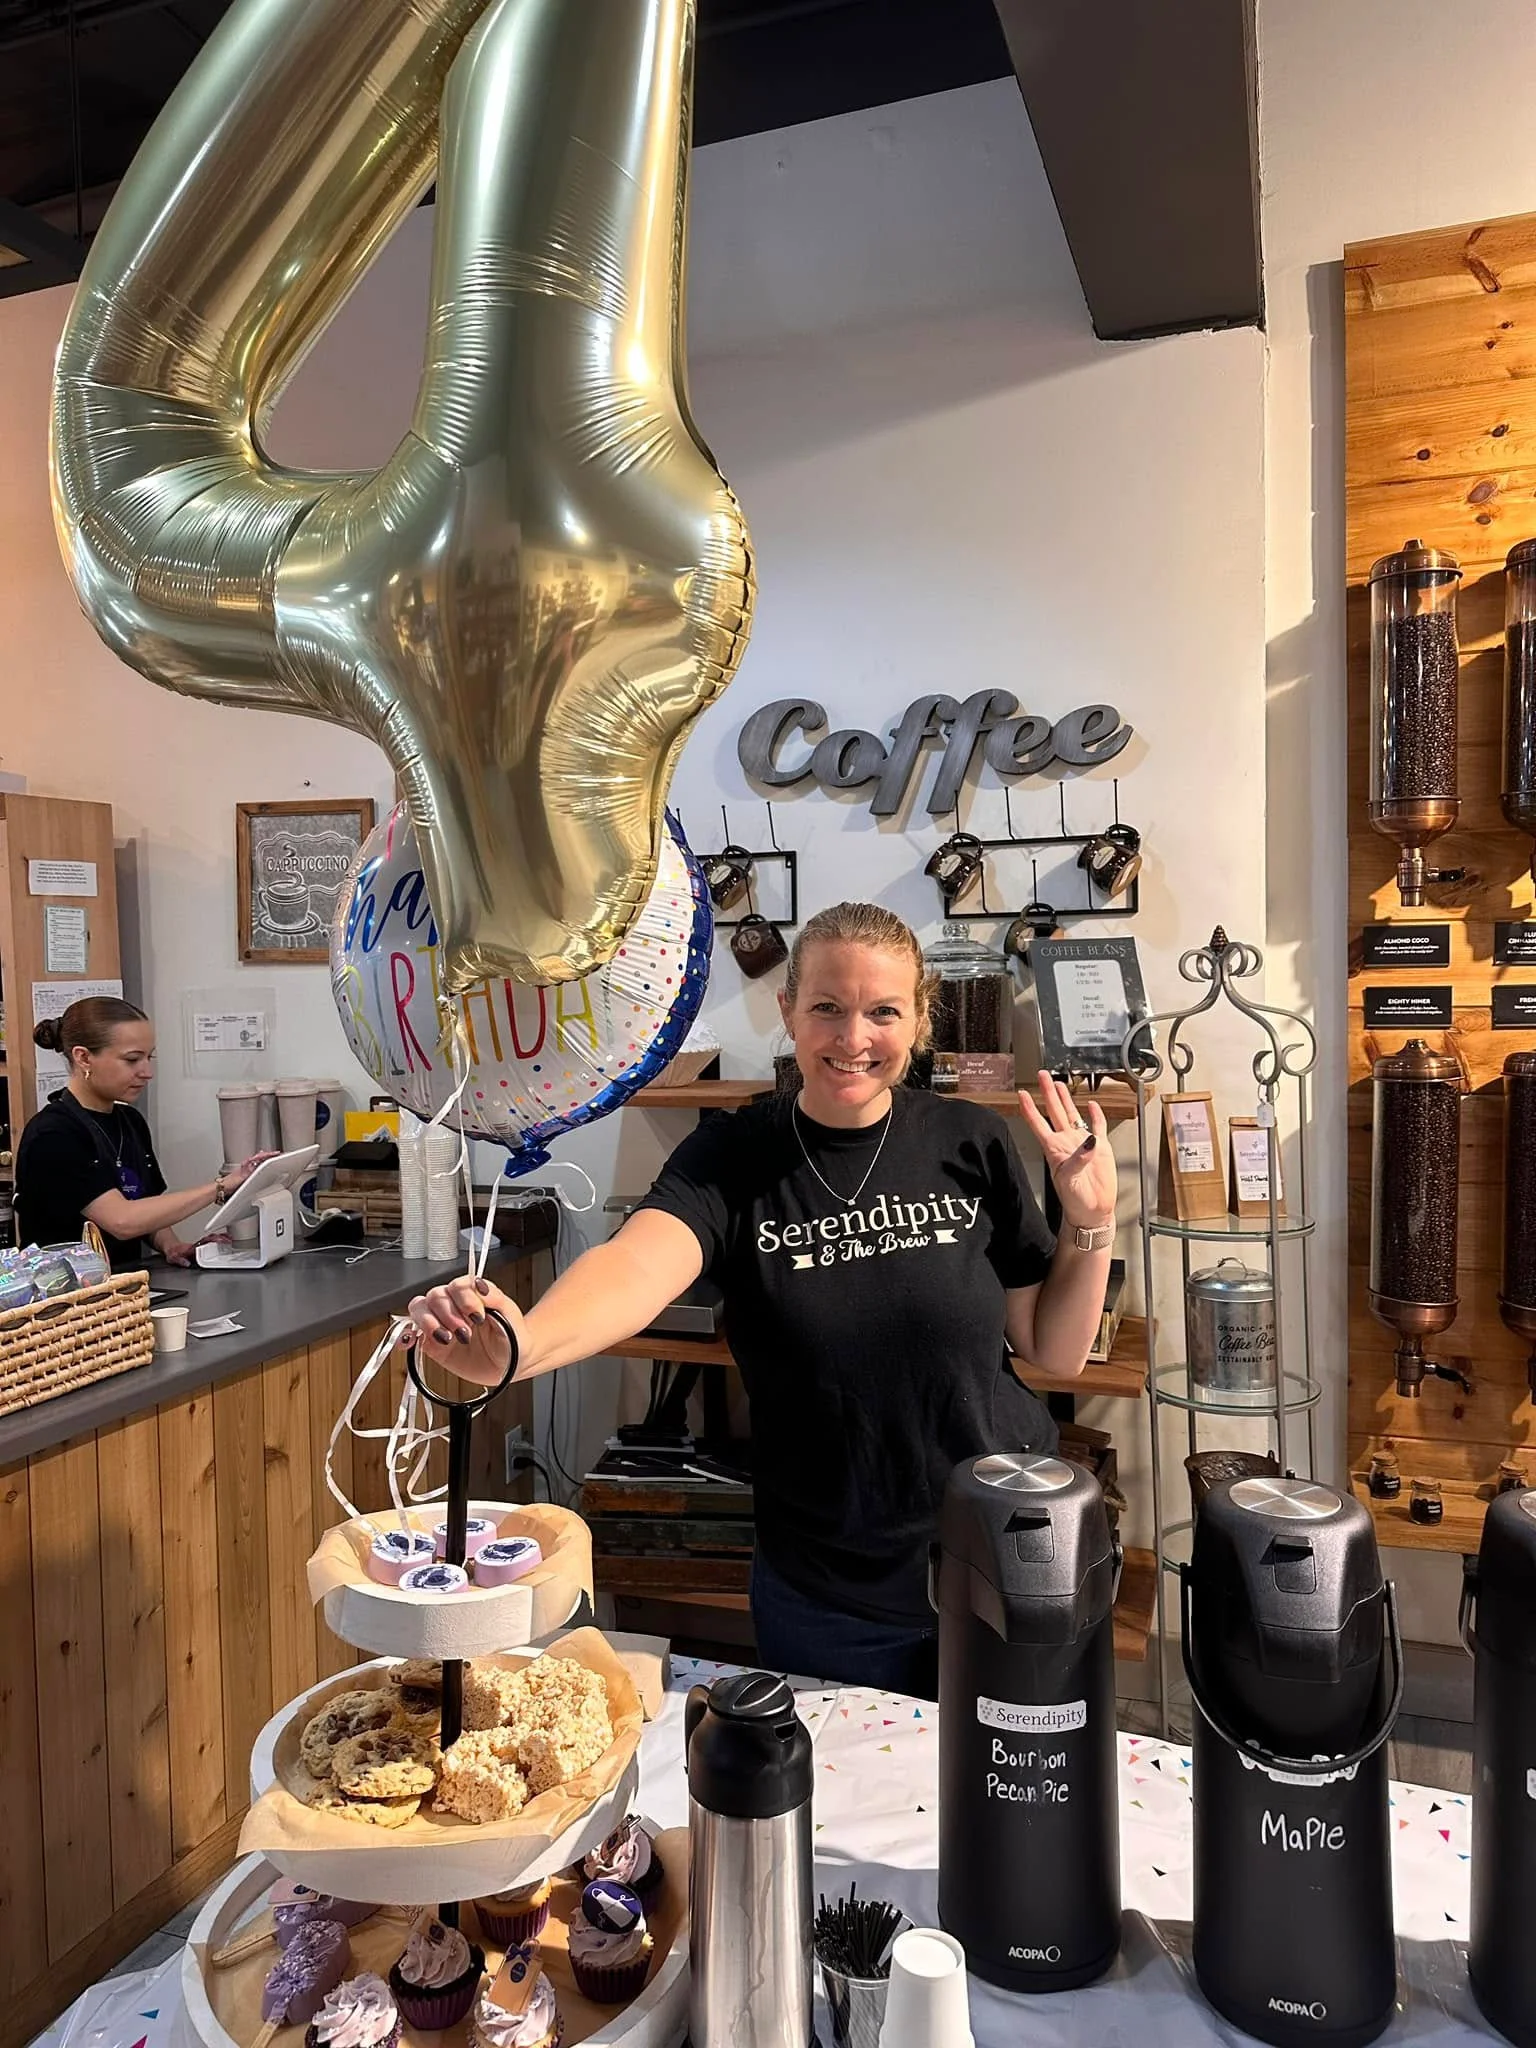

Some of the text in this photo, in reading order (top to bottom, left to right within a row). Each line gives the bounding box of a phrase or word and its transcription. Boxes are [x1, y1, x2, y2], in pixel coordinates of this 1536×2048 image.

[738, 688, 1133, 815] Coffee
[266, 856, 350, 873] CAPPUCCINO
[1040, 943, 1127, 957] COFFEE BEANS
[757, 1192, 983, 1253] Serendipity
[819, 1231, 931, 1266] & The Brew
[1219, 1334, 1252, 1352] Coffee
[996, 1707, 1084, 1728] Serendipity
[992, 1738, 1067, 1769] Bourbon
[986, 1772, 1070, 1803] Pecan Pie
